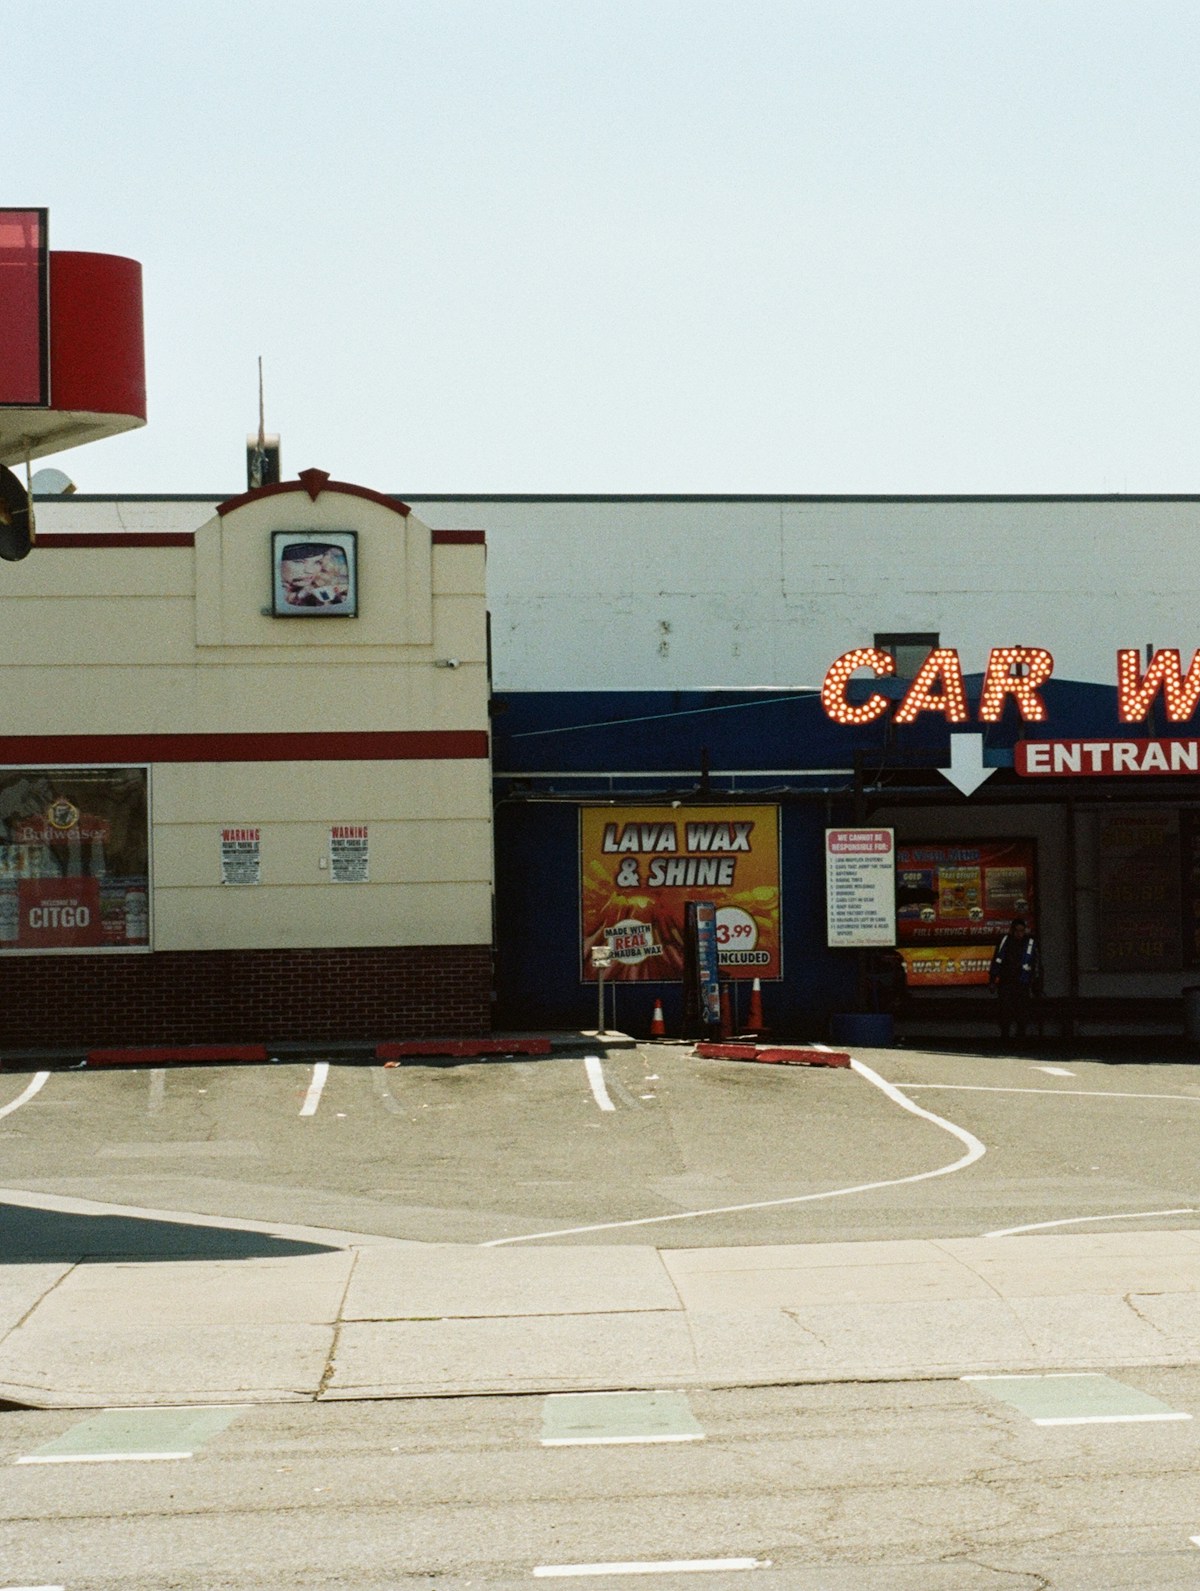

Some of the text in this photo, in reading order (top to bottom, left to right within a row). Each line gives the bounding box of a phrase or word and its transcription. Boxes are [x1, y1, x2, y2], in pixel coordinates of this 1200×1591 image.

[820, 646, 1054, 725] CAR
[22, 826, 107, 841] Budweiser
[222, 829, 260, 841] WARNING
[331, 826, 368, 838] WARNING
[602, 821, 754, 854] LAVA WAX
[849, 833, 873, 841] CANNOT
[874, 833, 882, 841] BE
[831, 843, 873, 852] RESPONSIBLE
[616, 857, 737, 887] & SHINE
[29, 906, 90, 929] CITGO
[605, 925, 651, 937] MADE WITH
[934, 928, 967, 936] SERVICE
[970, 927, 993, 935] WASH
[614, 934, 647, 951] REAL
[644, 946, 662, 956] WAX
[912, 962, 941, 973] WAX
[946, 961, 955, 973] &
[960, 960, 992, 972] SHIN
